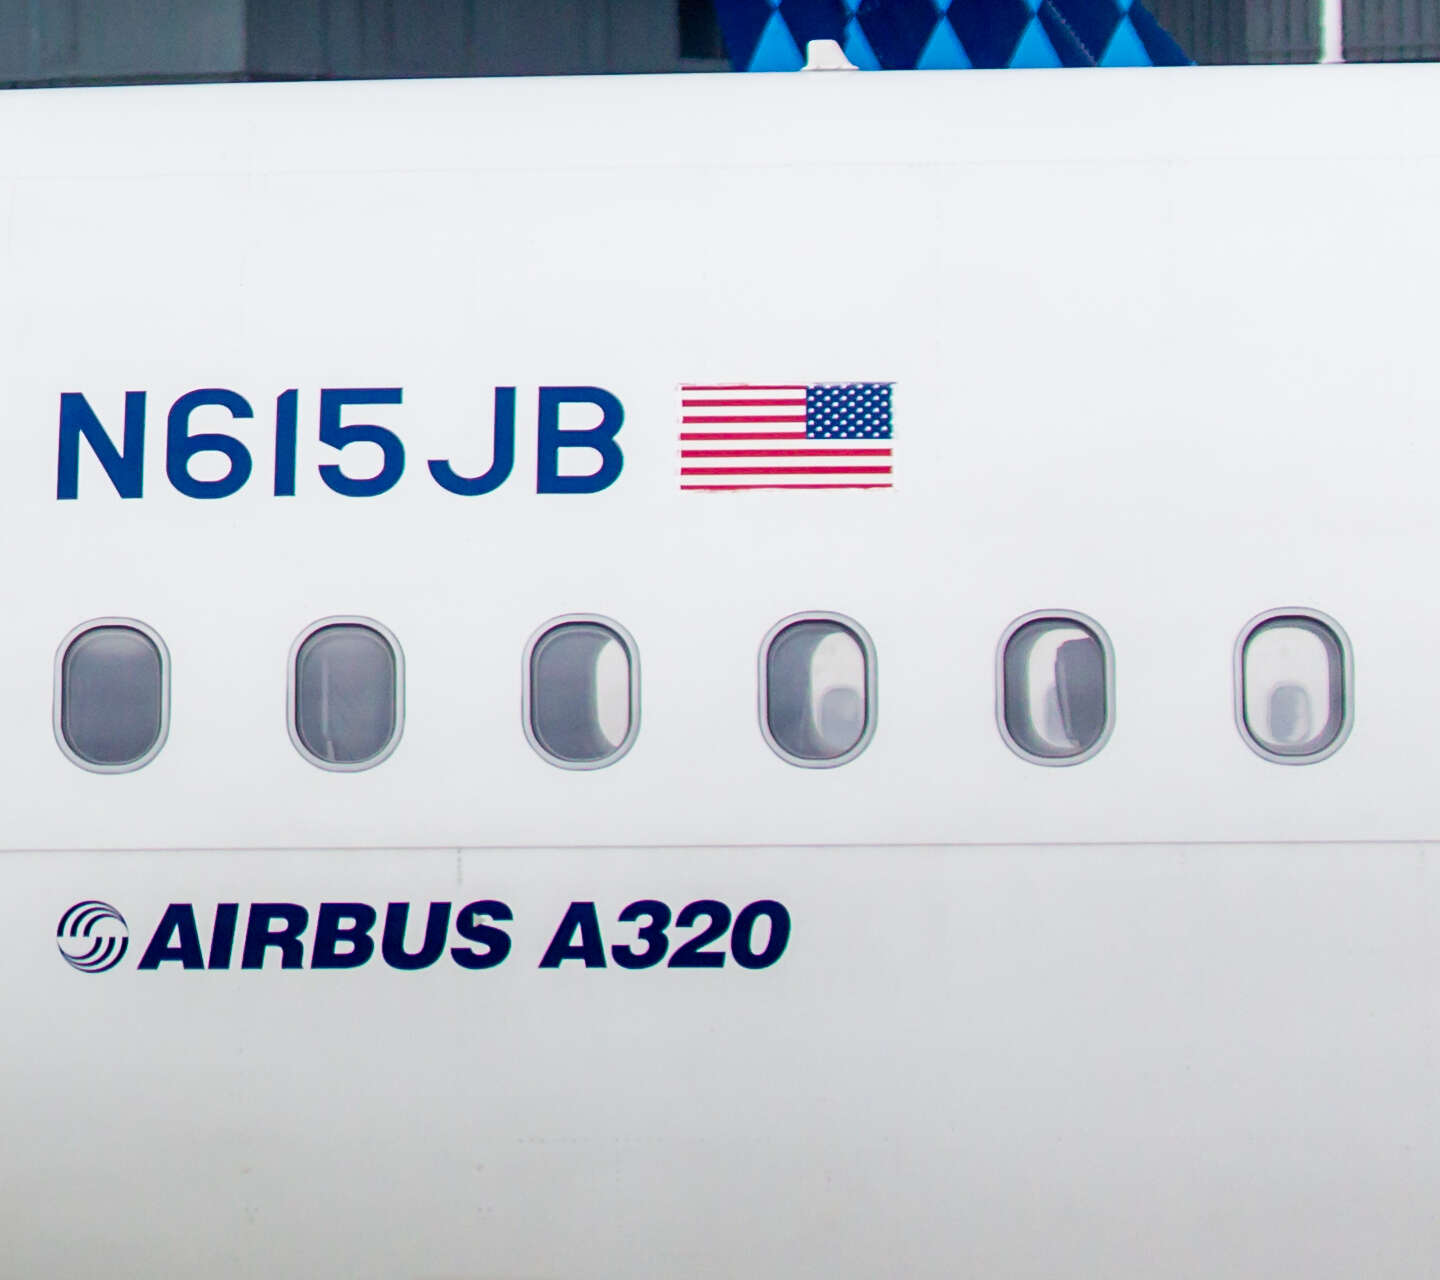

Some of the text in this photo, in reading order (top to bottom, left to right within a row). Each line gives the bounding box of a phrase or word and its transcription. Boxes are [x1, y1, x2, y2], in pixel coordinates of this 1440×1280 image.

[56, 386, 625, 500] N615JB
[136, 899, 793, 970] AIRBUS A320
